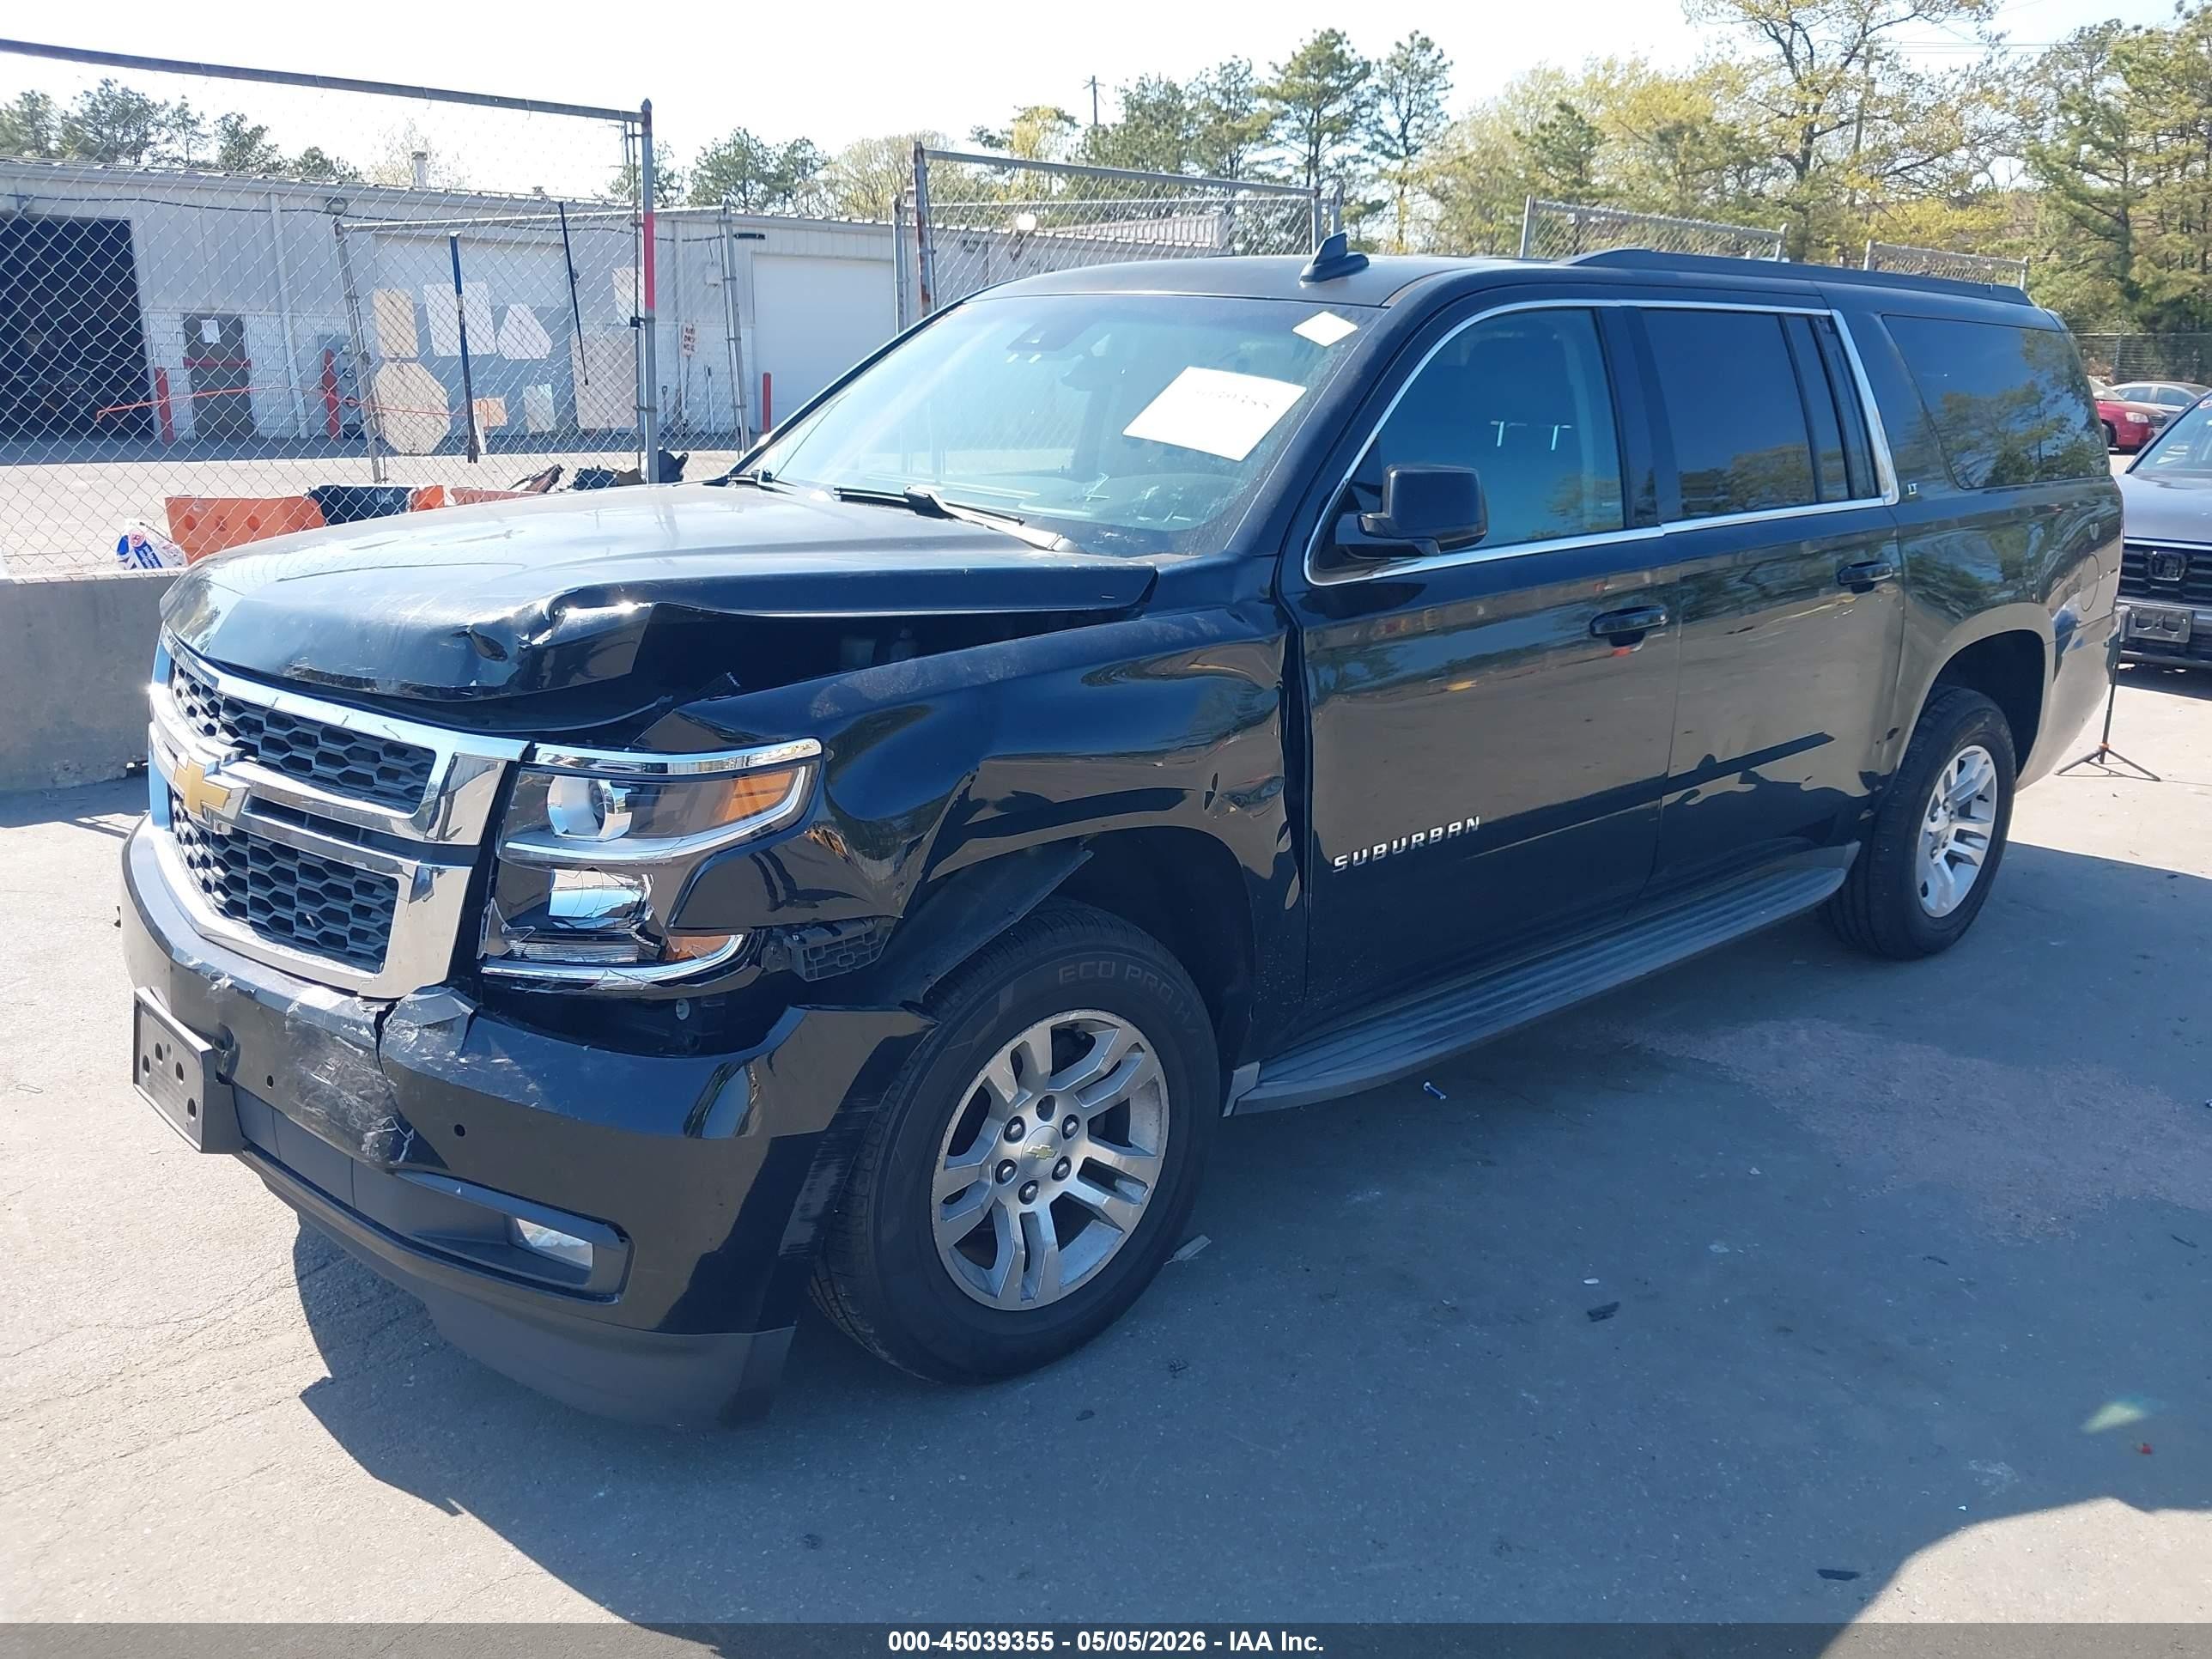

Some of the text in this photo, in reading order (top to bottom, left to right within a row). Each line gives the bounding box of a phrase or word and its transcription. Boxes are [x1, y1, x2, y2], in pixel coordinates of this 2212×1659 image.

[1332, 815, 1481, 873] SUBURBAN
[1058, 960, 1175, 1005] ECO PRO
